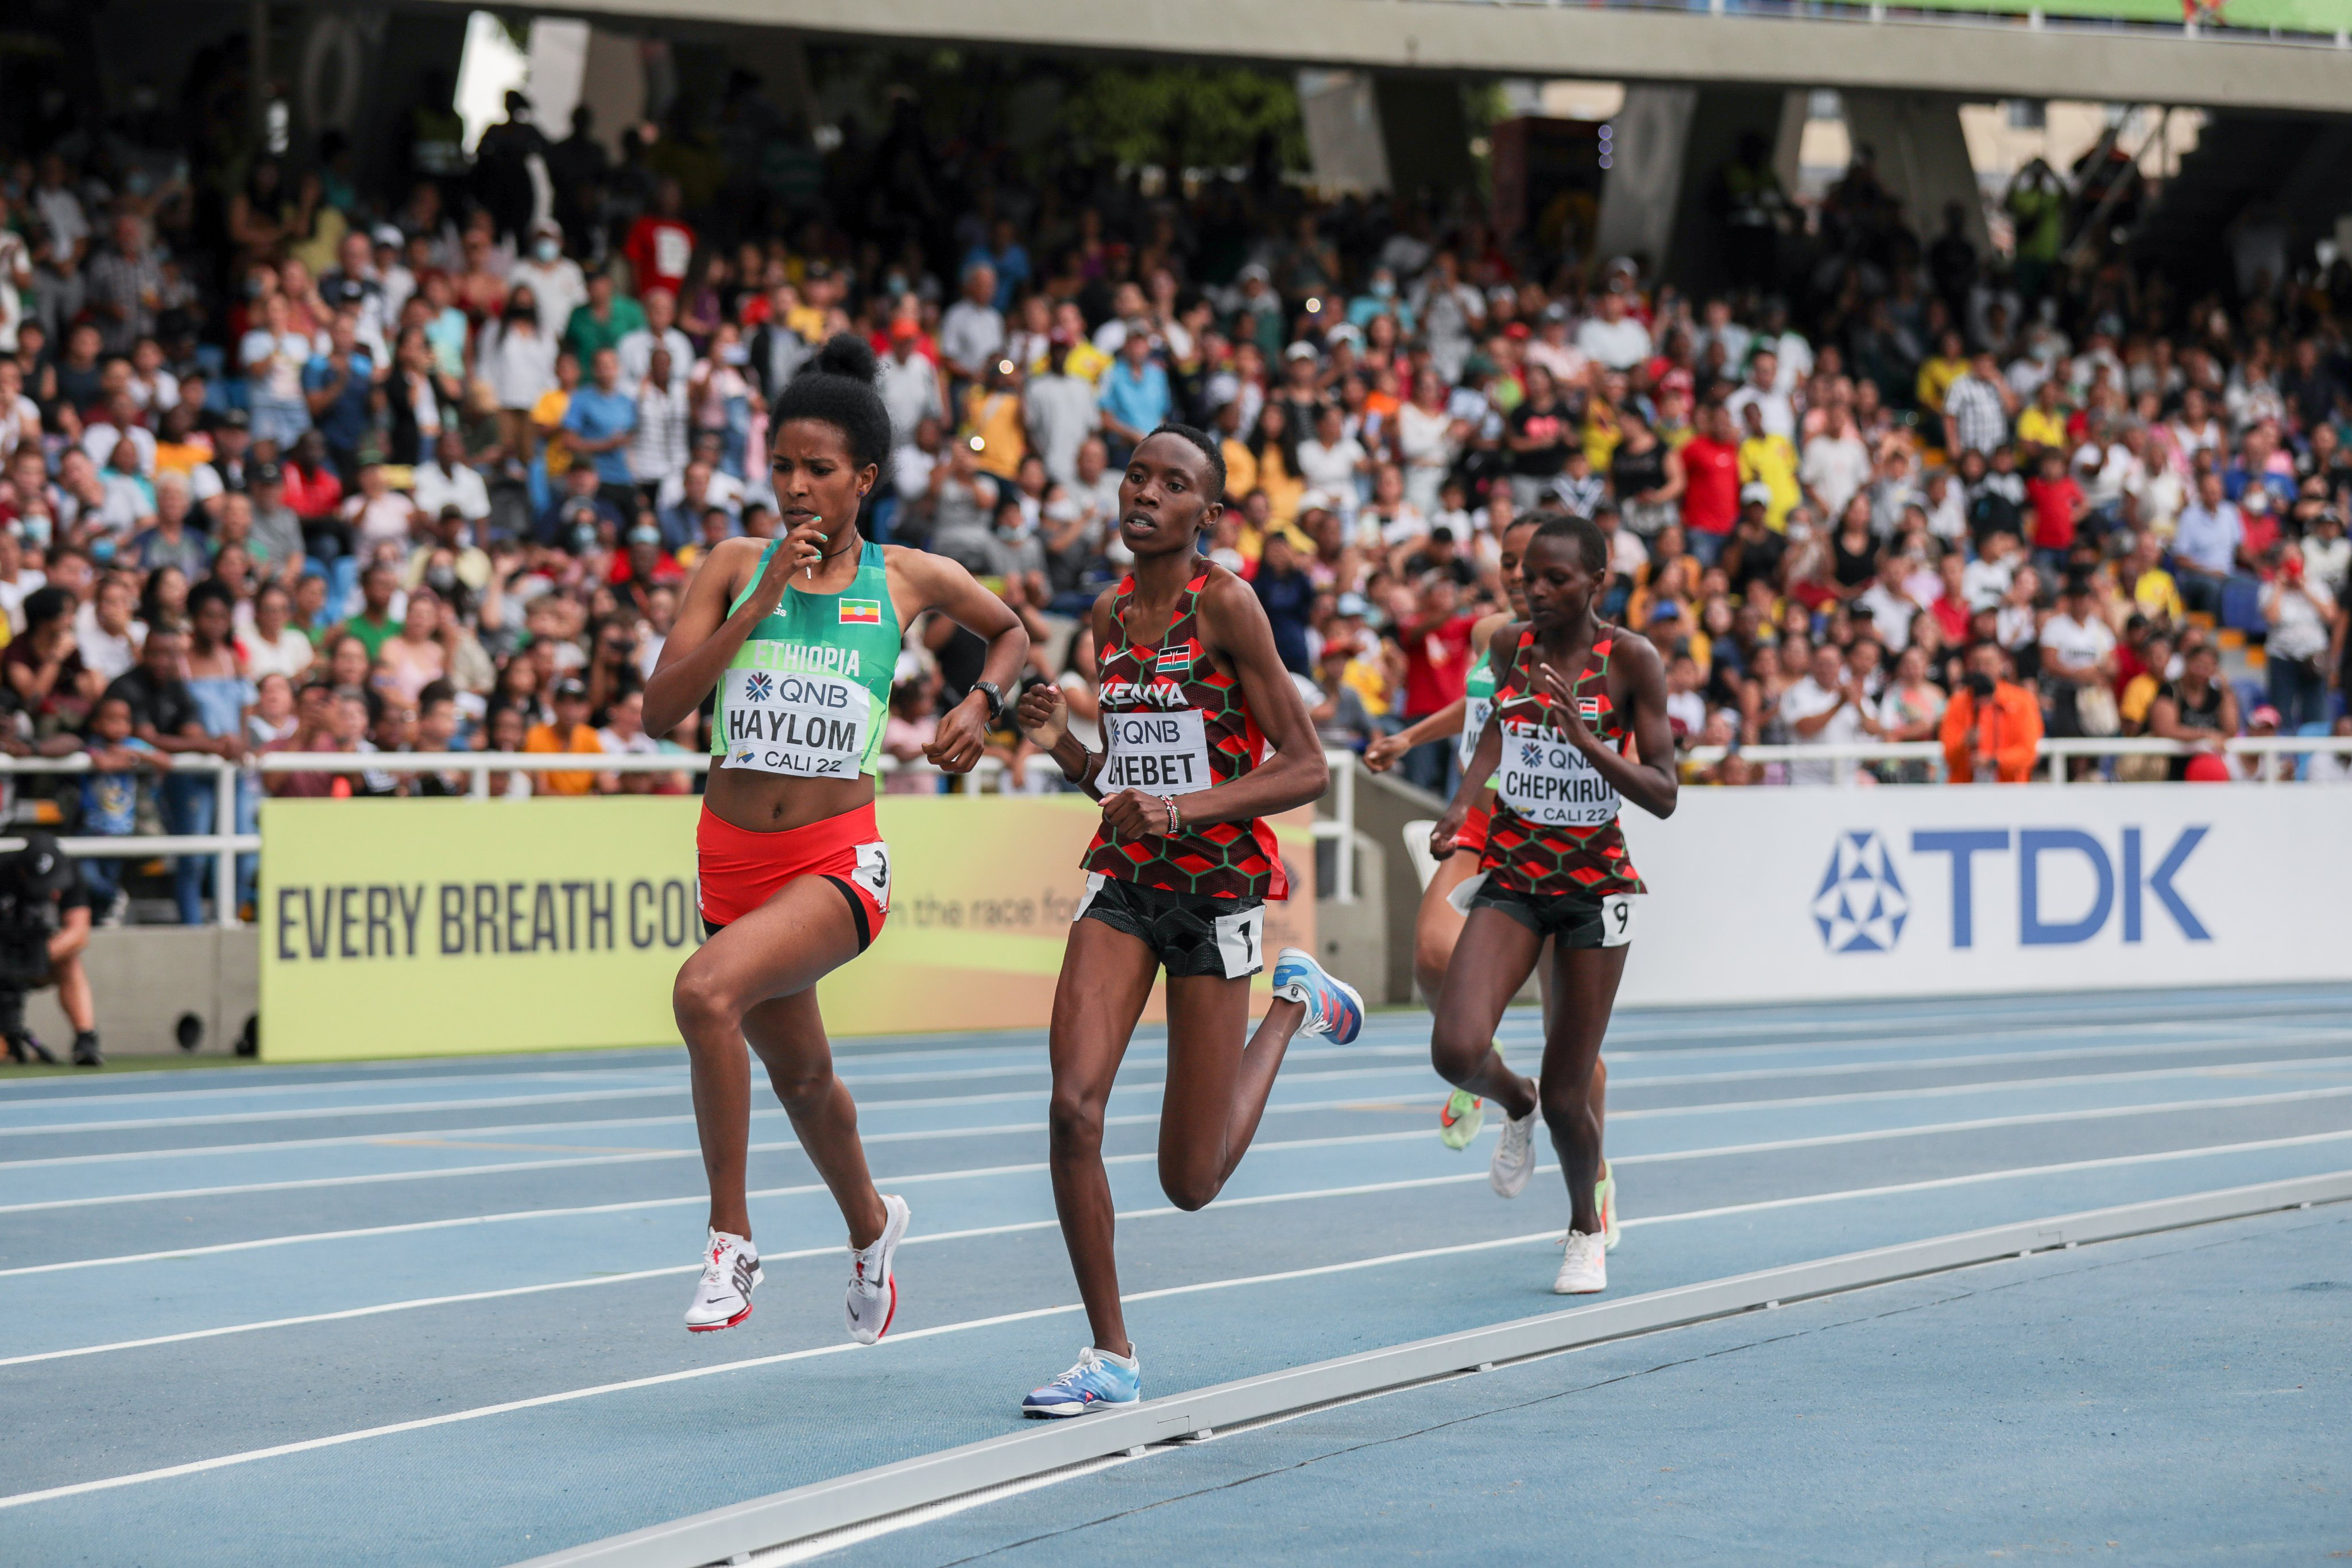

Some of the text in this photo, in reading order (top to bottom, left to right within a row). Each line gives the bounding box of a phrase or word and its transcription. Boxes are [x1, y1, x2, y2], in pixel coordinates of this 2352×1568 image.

[754, 639, 860, 677] ETHIOPIA
[780, 679, 848, 708] QNB
[1098, 683, 1190, 707] KENYA
[730, 710, 857, 752] HAYLOM
[1123, 720, 1181, 745] QNB
[1500, 719, 1569, 742] KEN
[764, 751, 843, 773] CALI 22
[1108, 753, 1196, 786] CHEBET
[1544, 807, 1608, 822] CALI 22
[1910, 824, 2212, 948] TDK
[277, 884, 425, 960] EVERY
[440, 880, 614, 955] BREATH
[913, 891, 964, 928] the
[969, 897, 1036, 927] race
[1614, 901, 1628, 935] 9
[1237, 920, 1253, 963] 1
